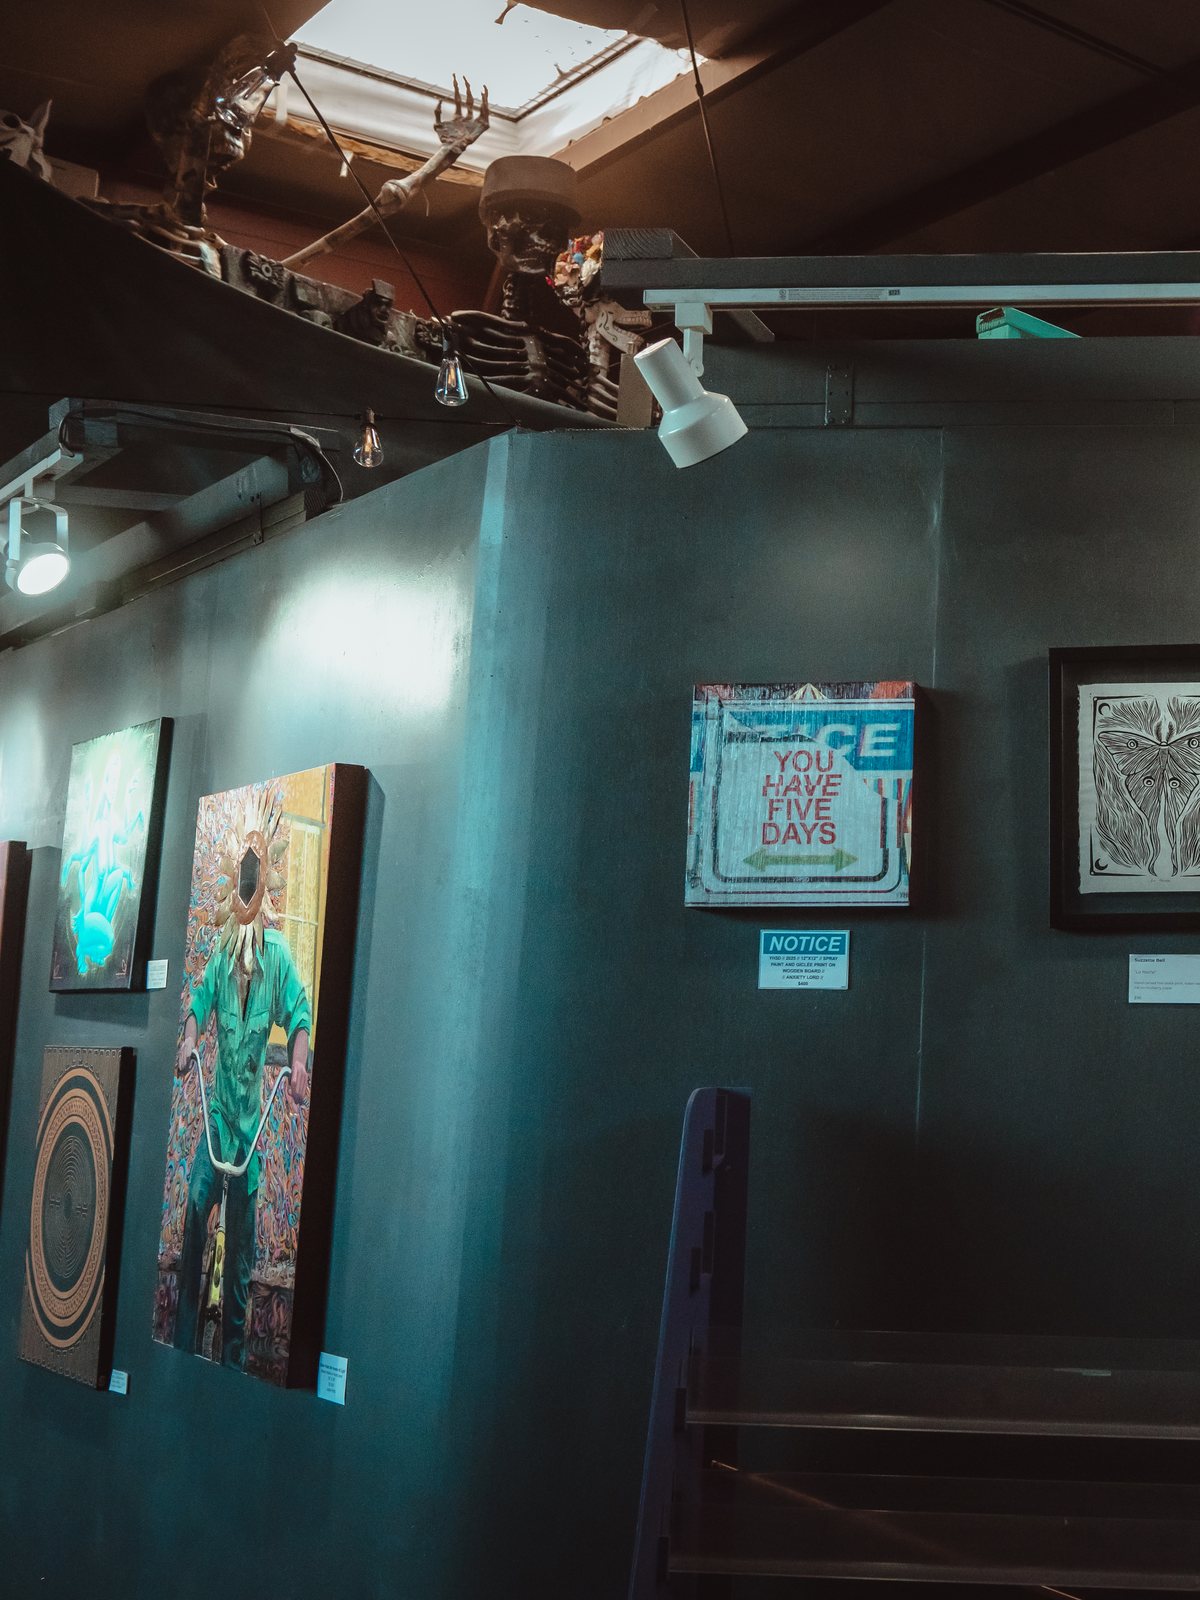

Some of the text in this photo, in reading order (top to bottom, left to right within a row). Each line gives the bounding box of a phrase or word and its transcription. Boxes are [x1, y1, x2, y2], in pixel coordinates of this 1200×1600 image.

[774, 750, 834, 773] YOU
[762, 774, 842, 797] HAVE
[767, 798, 832, 821] FIVE
[762, 822, 836, 845] DAYS
[769, 936, 842, 952] NOTICE
